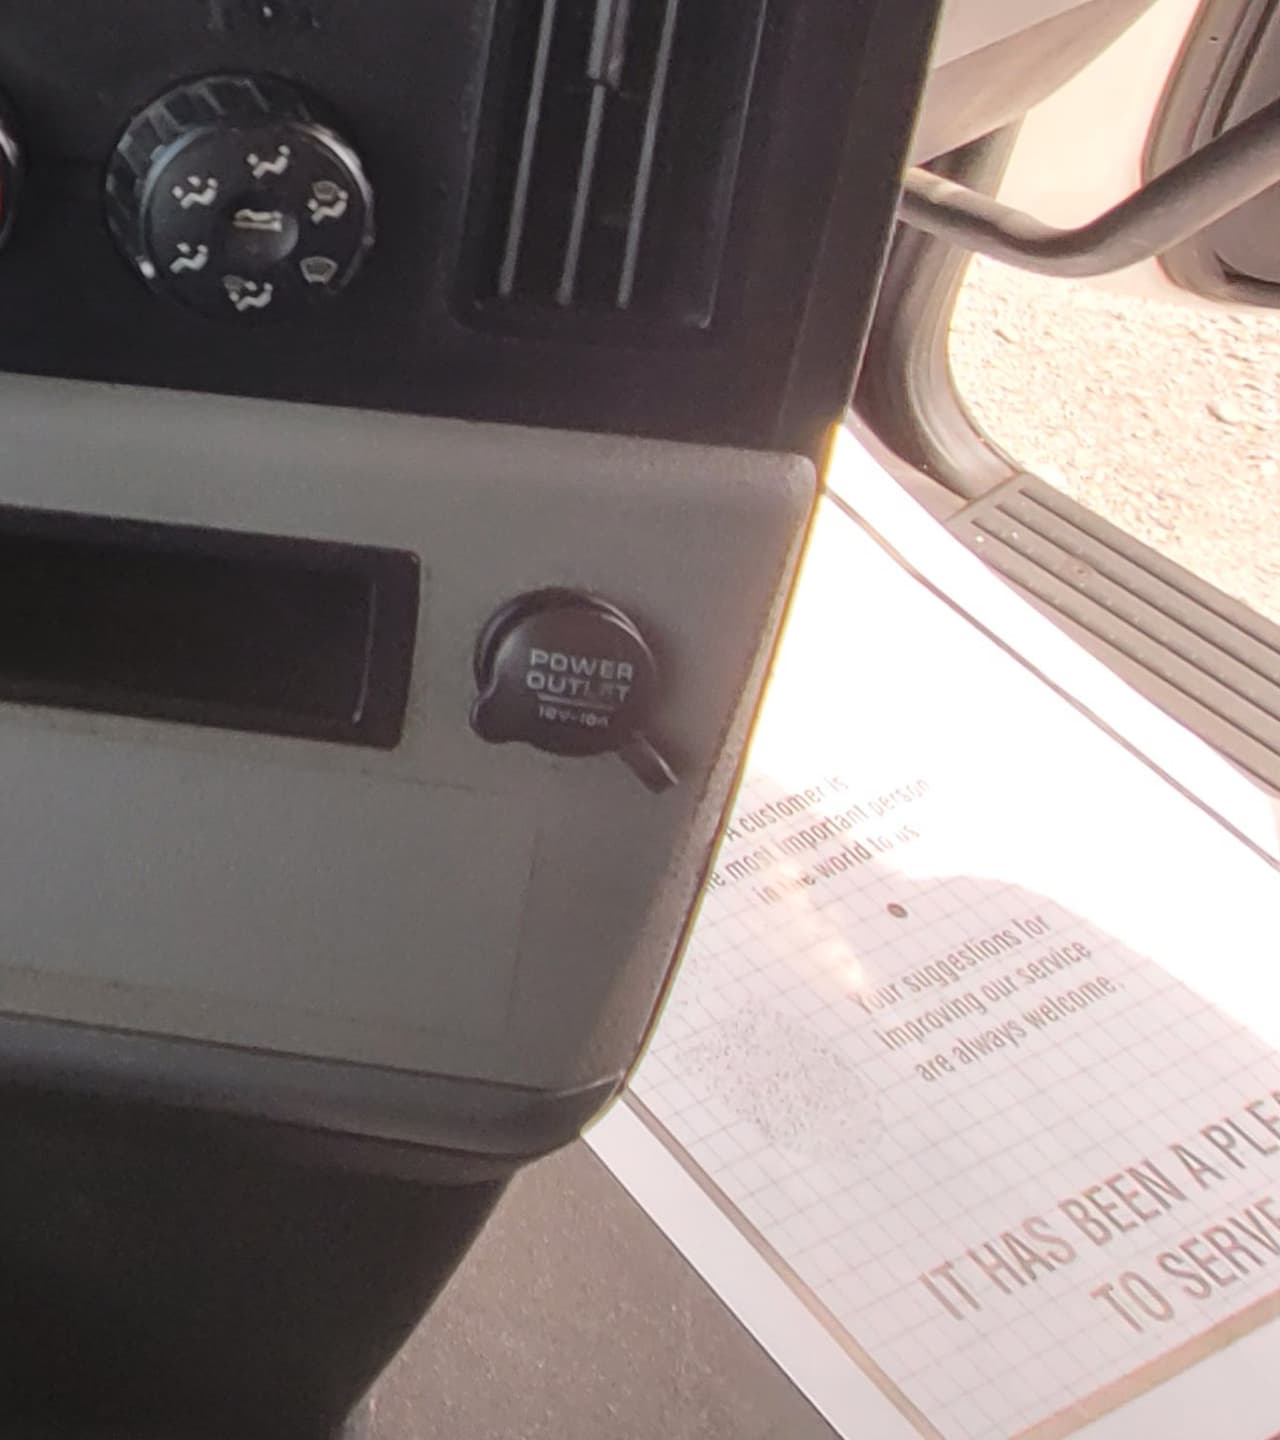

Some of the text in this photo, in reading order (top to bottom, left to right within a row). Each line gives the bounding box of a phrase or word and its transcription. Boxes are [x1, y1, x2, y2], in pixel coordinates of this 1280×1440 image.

[530, 647, 635, 682] POWER
[724, 825, 744, 843] A
[740, 784, 827, 834] customer
[725, 842, 776, 882] most
[867, 777, 931, 818] person
[751, 883, 780, 907] in
[814, 840, 873, 879] world
[866, 834, 894, 854] to
[846, 913, 1053, 1016] Your suggestions for
[979, 973, 1021, 1003] our
[1015, 939, 1093, 986] service
[913, 1052, 957, 1083] are
[951, 1017, 1028, 1067] always
[917, 1089, 1280, 1322] IT HAS BEEN A PLE
[1088, 1270, 1175, 1335] TO
